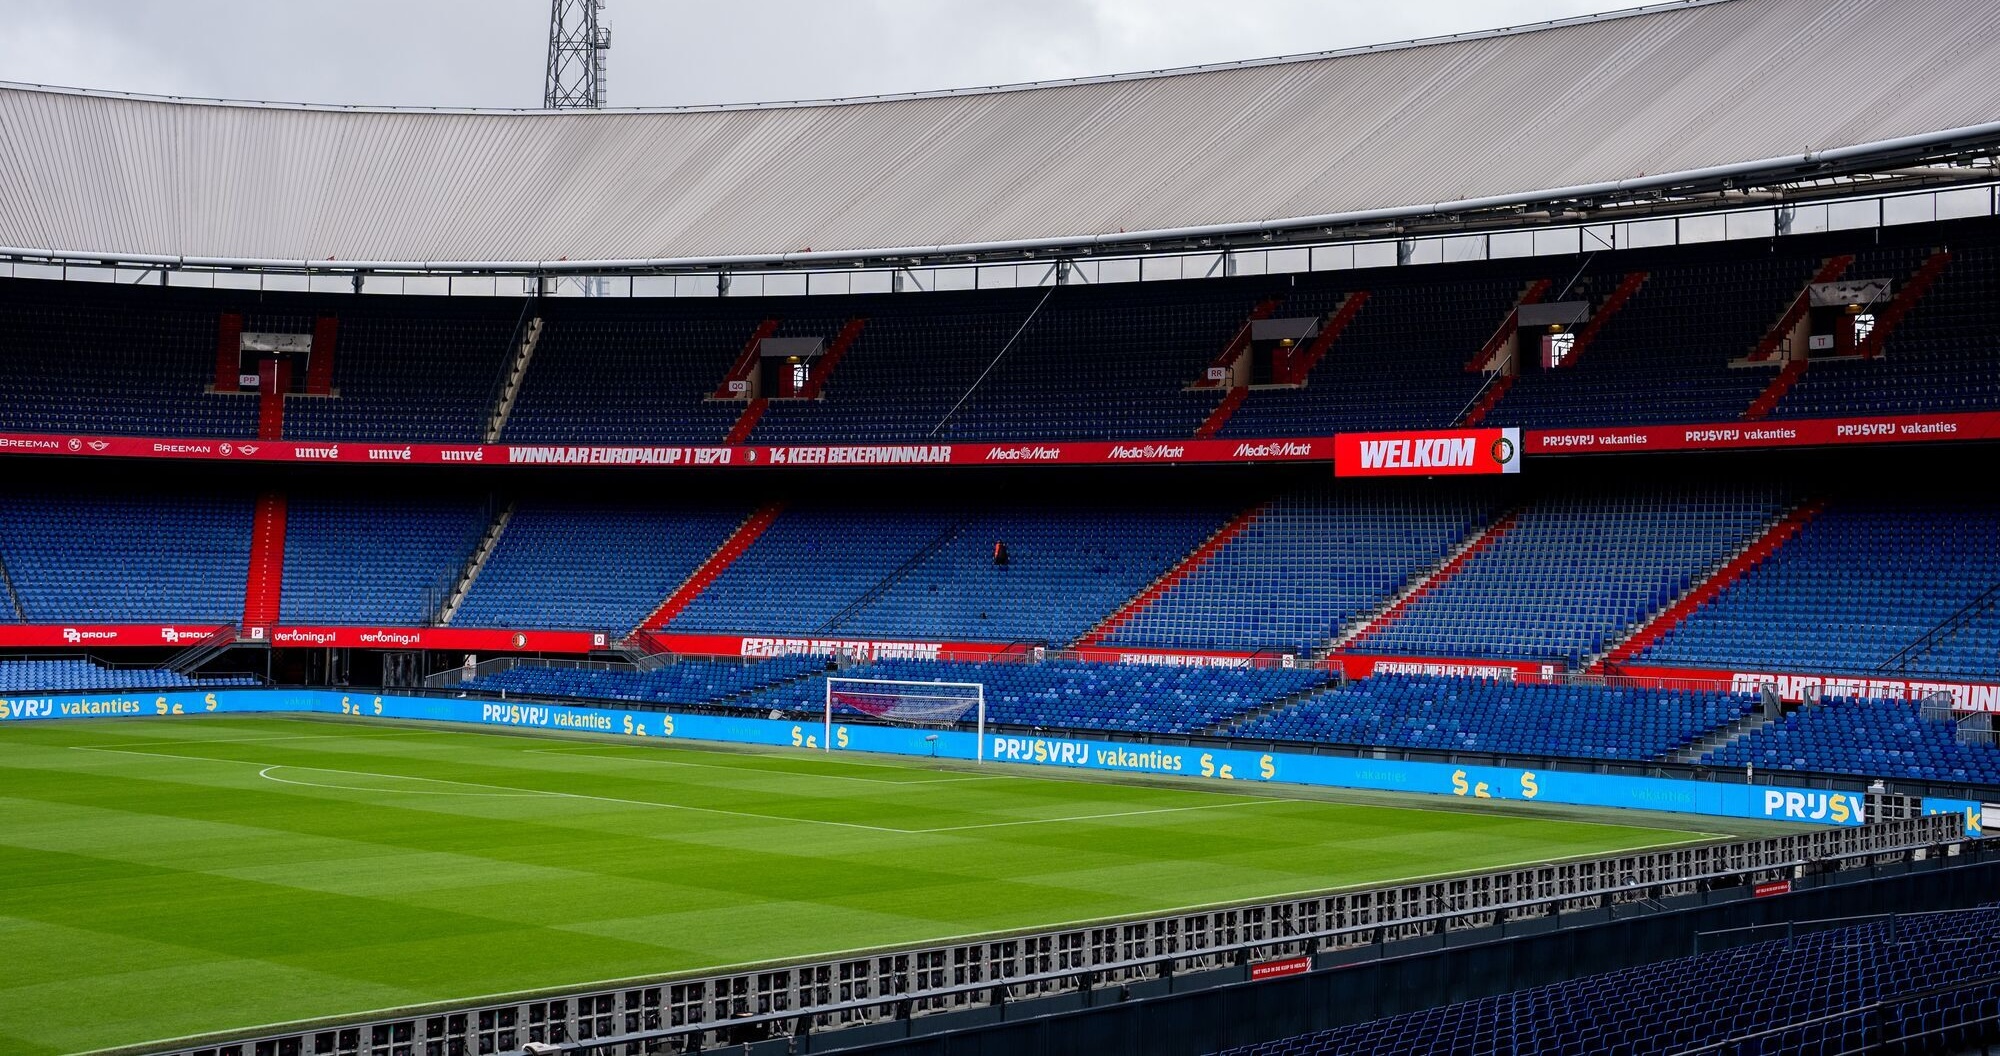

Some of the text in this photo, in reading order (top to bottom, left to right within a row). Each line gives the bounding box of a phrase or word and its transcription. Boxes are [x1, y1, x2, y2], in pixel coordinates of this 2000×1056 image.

[1211, 369, 1222, 377] RR
[1743, 428, 1796, 440] vakanties
[1900, 422, 1957, 434] vakanties
[0, 438, 59, 449] BREEMAN
[1598, 433, 1647, 445] vakanties
[153, 443, 211, 453] BREEMAN
[294, 444, 339, 459] univé
[368, 446, 412, 460] univé
[441, 447, 483, 461] univé
[508, 446, 589, 464] WINNAAR
[590, 447, 682, 464] EUROPACUP
[694, 448, 732, 464] 1970
[769, 446, 952, 464] 14 KEER BEKERWINNAAR
[1360, 438, 1476, 468] WELKOM
[81, 631, 118, 639] GROUP
[274, 629, 336, 644] verloning.nl
[360, 630, 420, 646] verloning.nl
[1909, 682, 2000, 713] TRIBUN
[62, 700, 139, 714] vakanties
[554, 712, 610, 728] vakanties
[1097, 748, 1181, 770] vakanties
